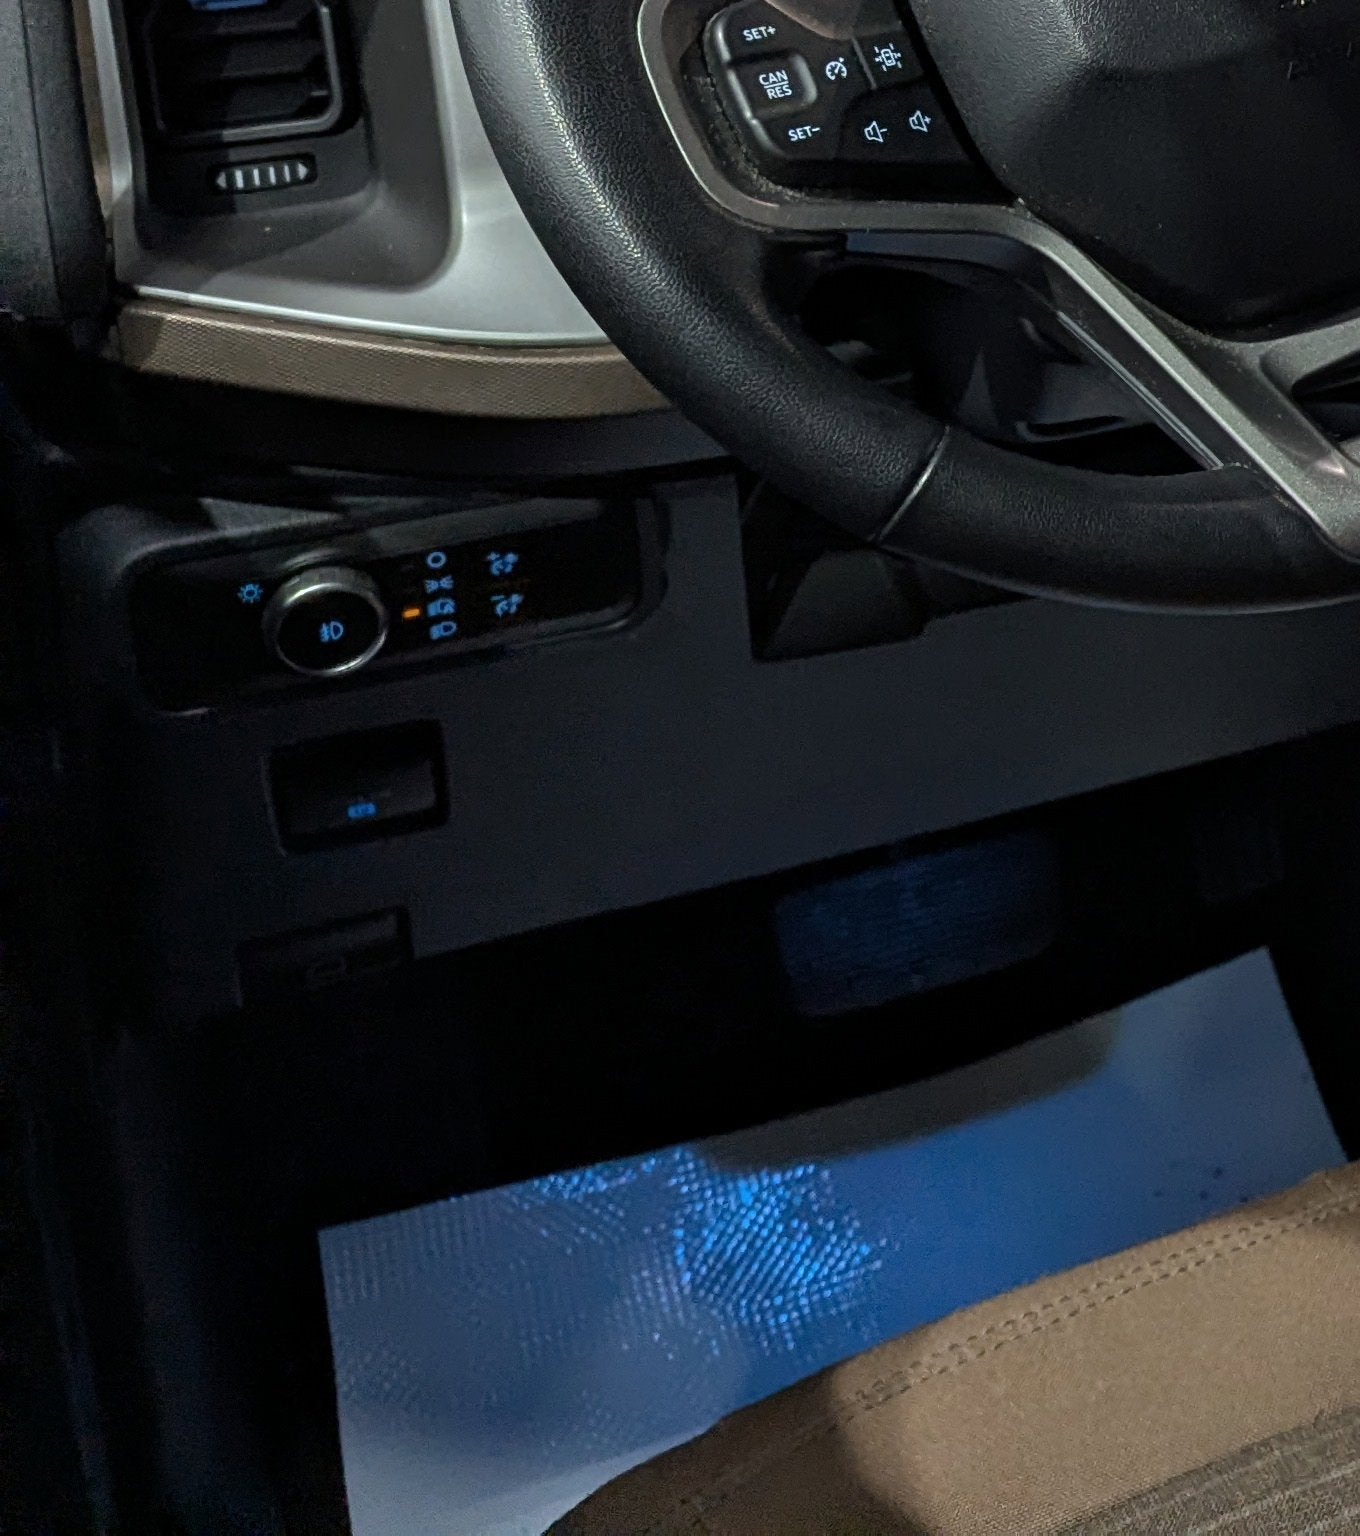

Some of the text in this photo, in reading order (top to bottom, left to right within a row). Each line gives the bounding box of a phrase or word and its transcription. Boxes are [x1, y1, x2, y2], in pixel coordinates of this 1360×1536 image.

[743, 24, 778, 42] SET+
[758, 69, 790, 86] CAN
[766, 85, 793, 100] RES
